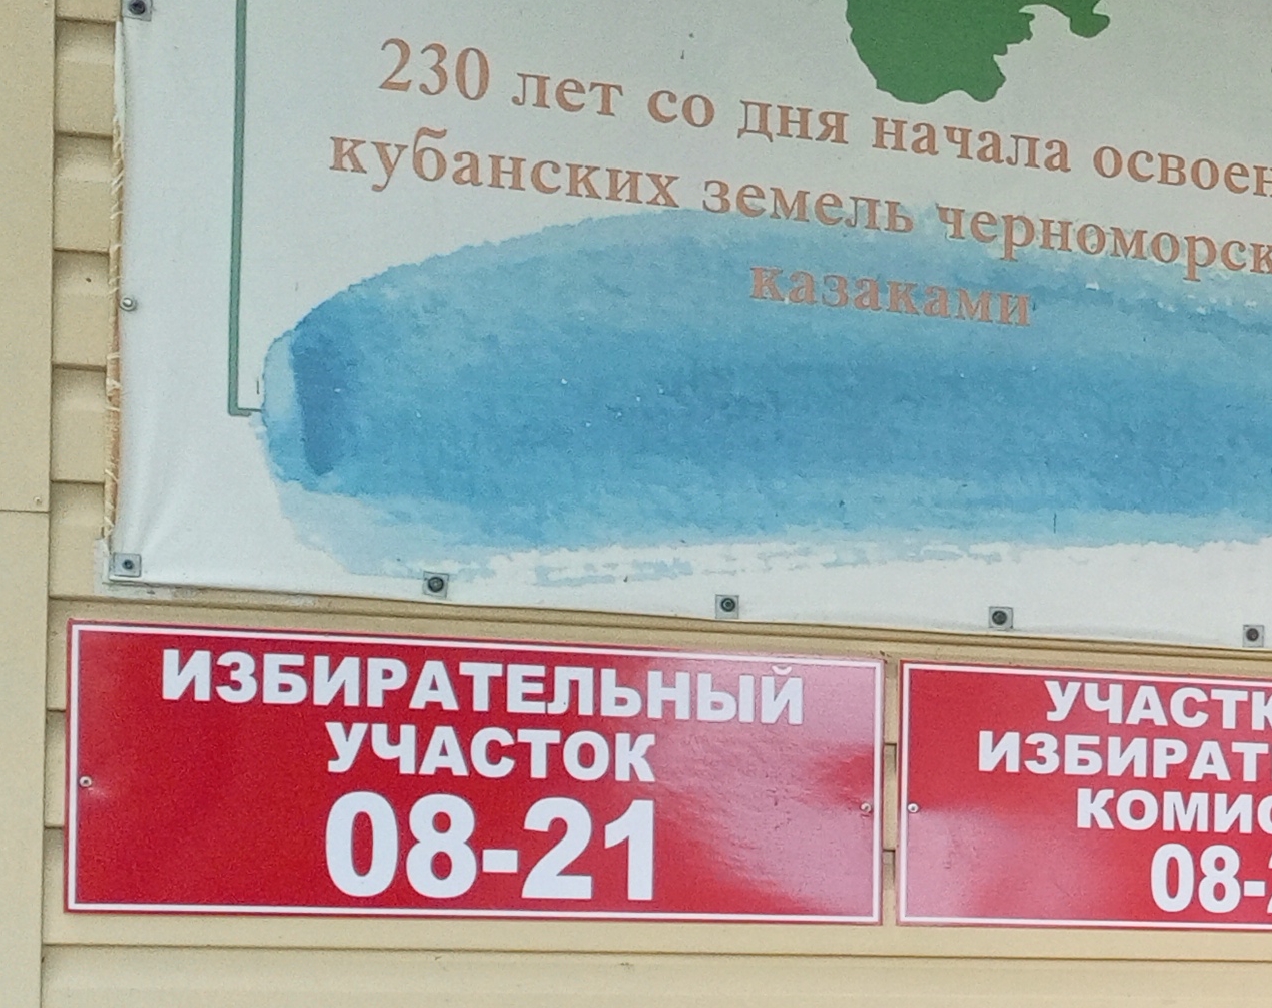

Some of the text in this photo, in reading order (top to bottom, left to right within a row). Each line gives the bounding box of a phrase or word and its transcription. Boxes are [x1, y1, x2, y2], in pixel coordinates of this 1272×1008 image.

[379, 37, 490, 100] 230
[512, 70, 623, 117] лет
[647, 88, 715, 128] со
[737, 99, 849, 145] дня
[872, 115, 1071, 173] начала
[329, 126, 680, 209] кубанских
[702, 179, 914, 234] земель
[750, 265, 1031, 327] казаками
[161, 648, 804, 726] ИЗБИРАТЕЛЬНЫЙ
[324, 721, 656, 783] УЧАСТОК
[324, 790, 655, 903] 08-21
